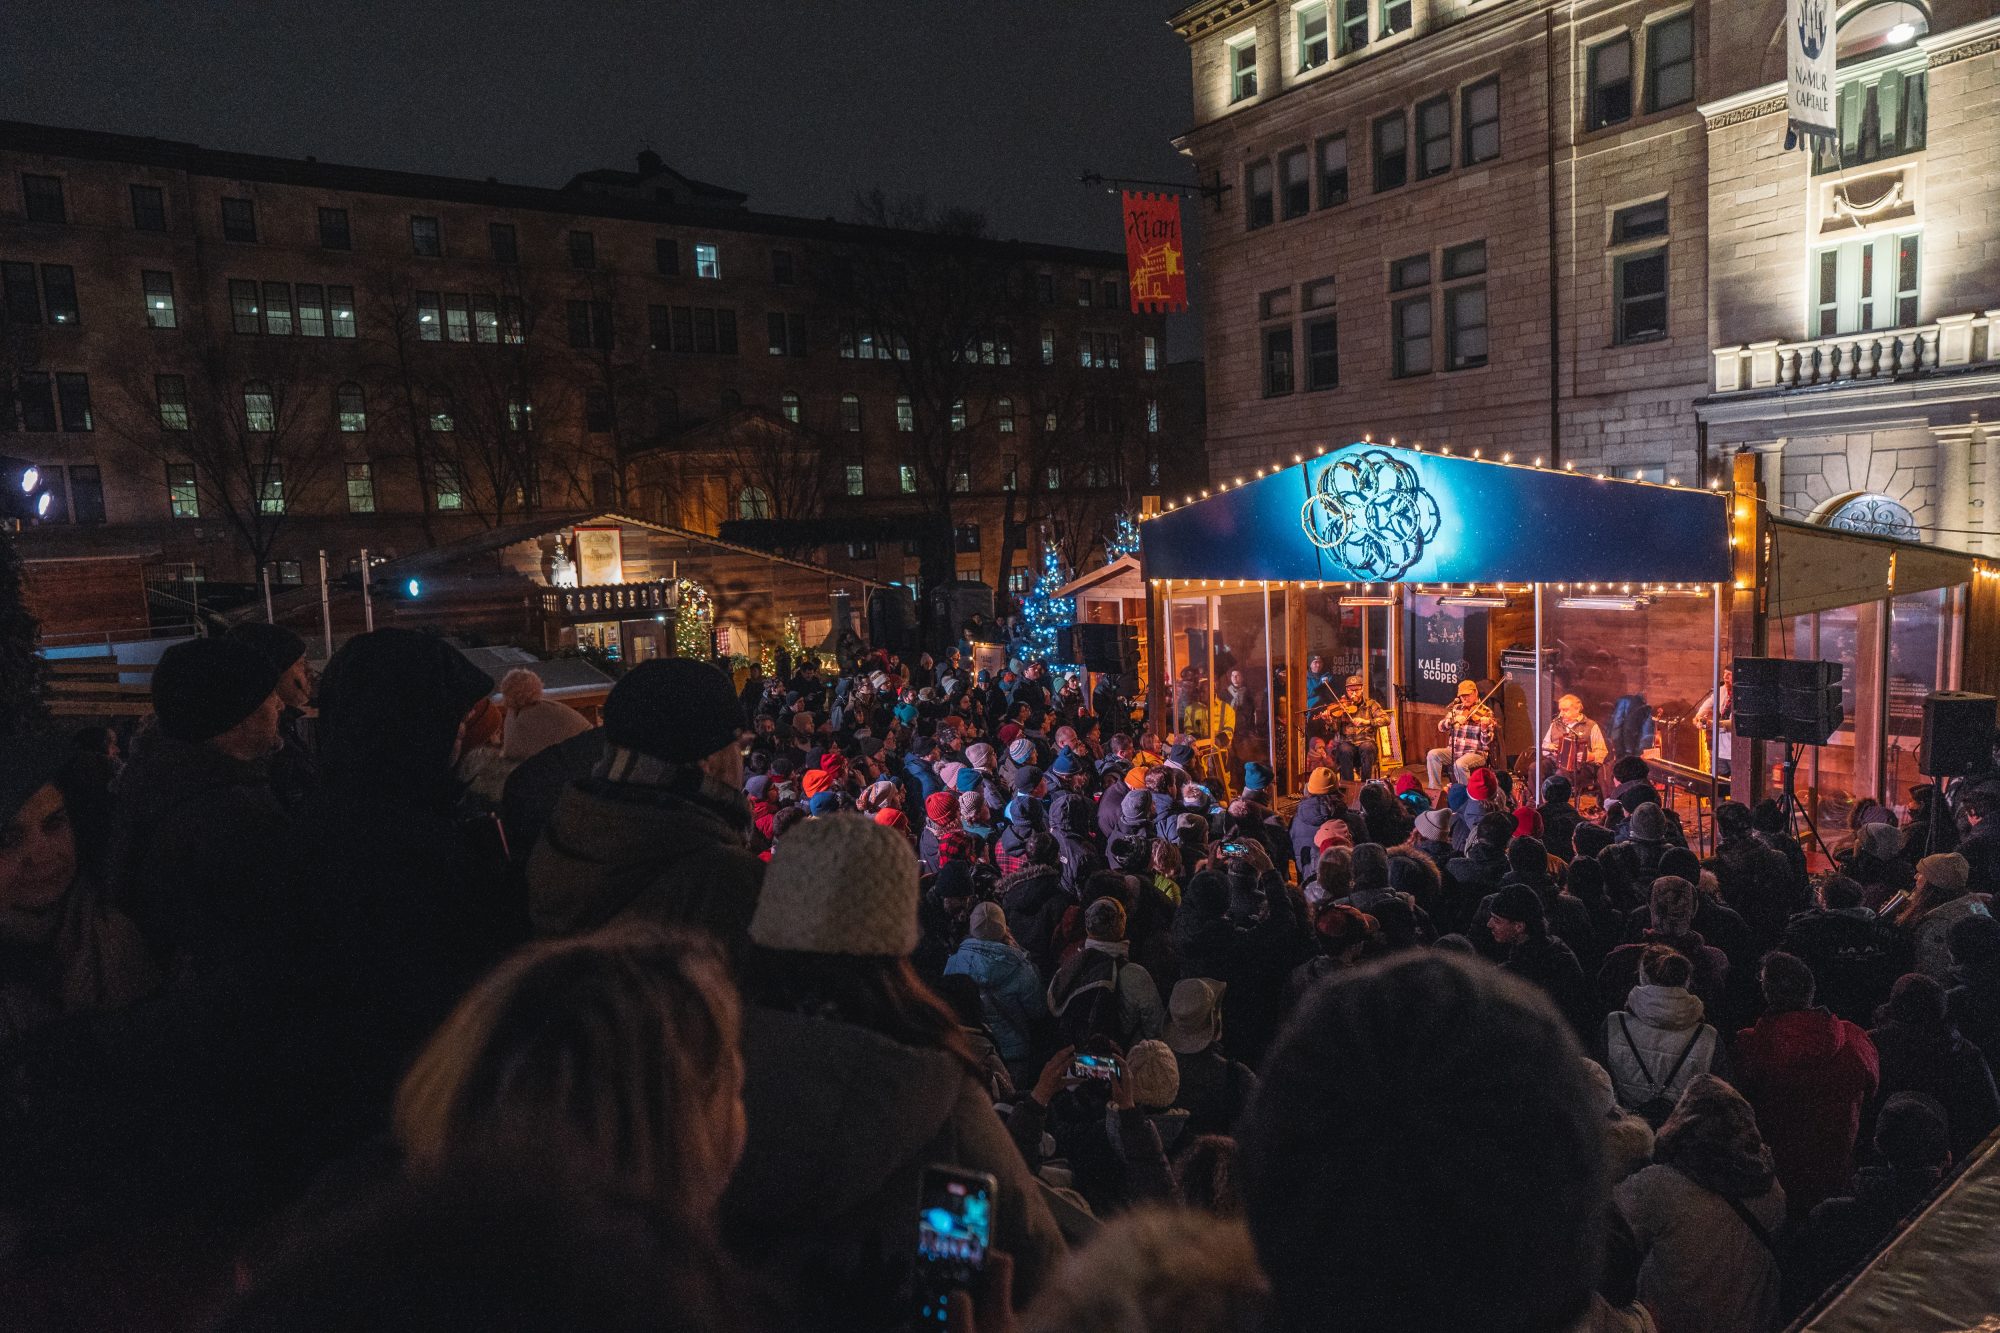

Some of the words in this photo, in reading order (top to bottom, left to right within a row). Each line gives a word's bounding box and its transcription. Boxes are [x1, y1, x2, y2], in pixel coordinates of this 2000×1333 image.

[1795, 65, 1827, 92] NAMUR
[1796, 89, 1829, 112] CAPITALE
[1423, 669, 1458, 684] SCOPES
